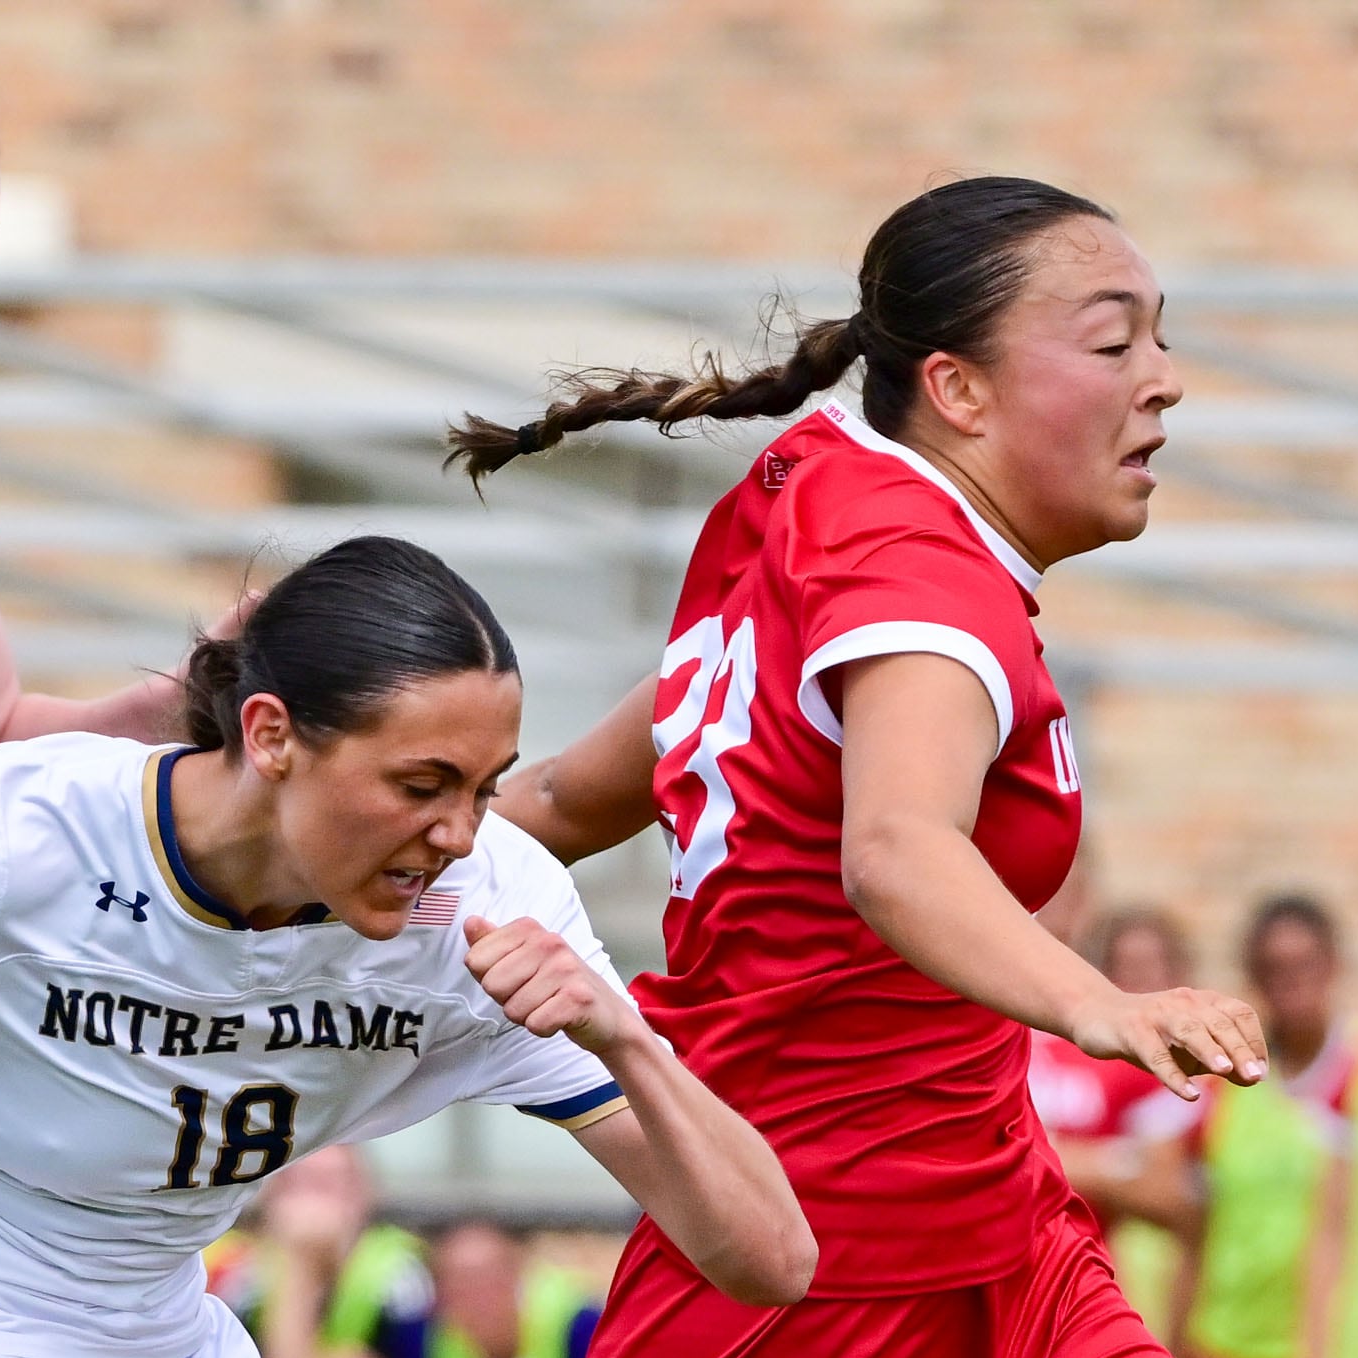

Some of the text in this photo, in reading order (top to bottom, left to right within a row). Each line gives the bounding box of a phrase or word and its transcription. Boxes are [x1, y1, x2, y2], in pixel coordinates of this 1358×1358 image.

[824, 403, 847, 423] 1993
[38, 982, 424, 1059] NOTRE DAME
[152, 1083, 301, 1193] 18
